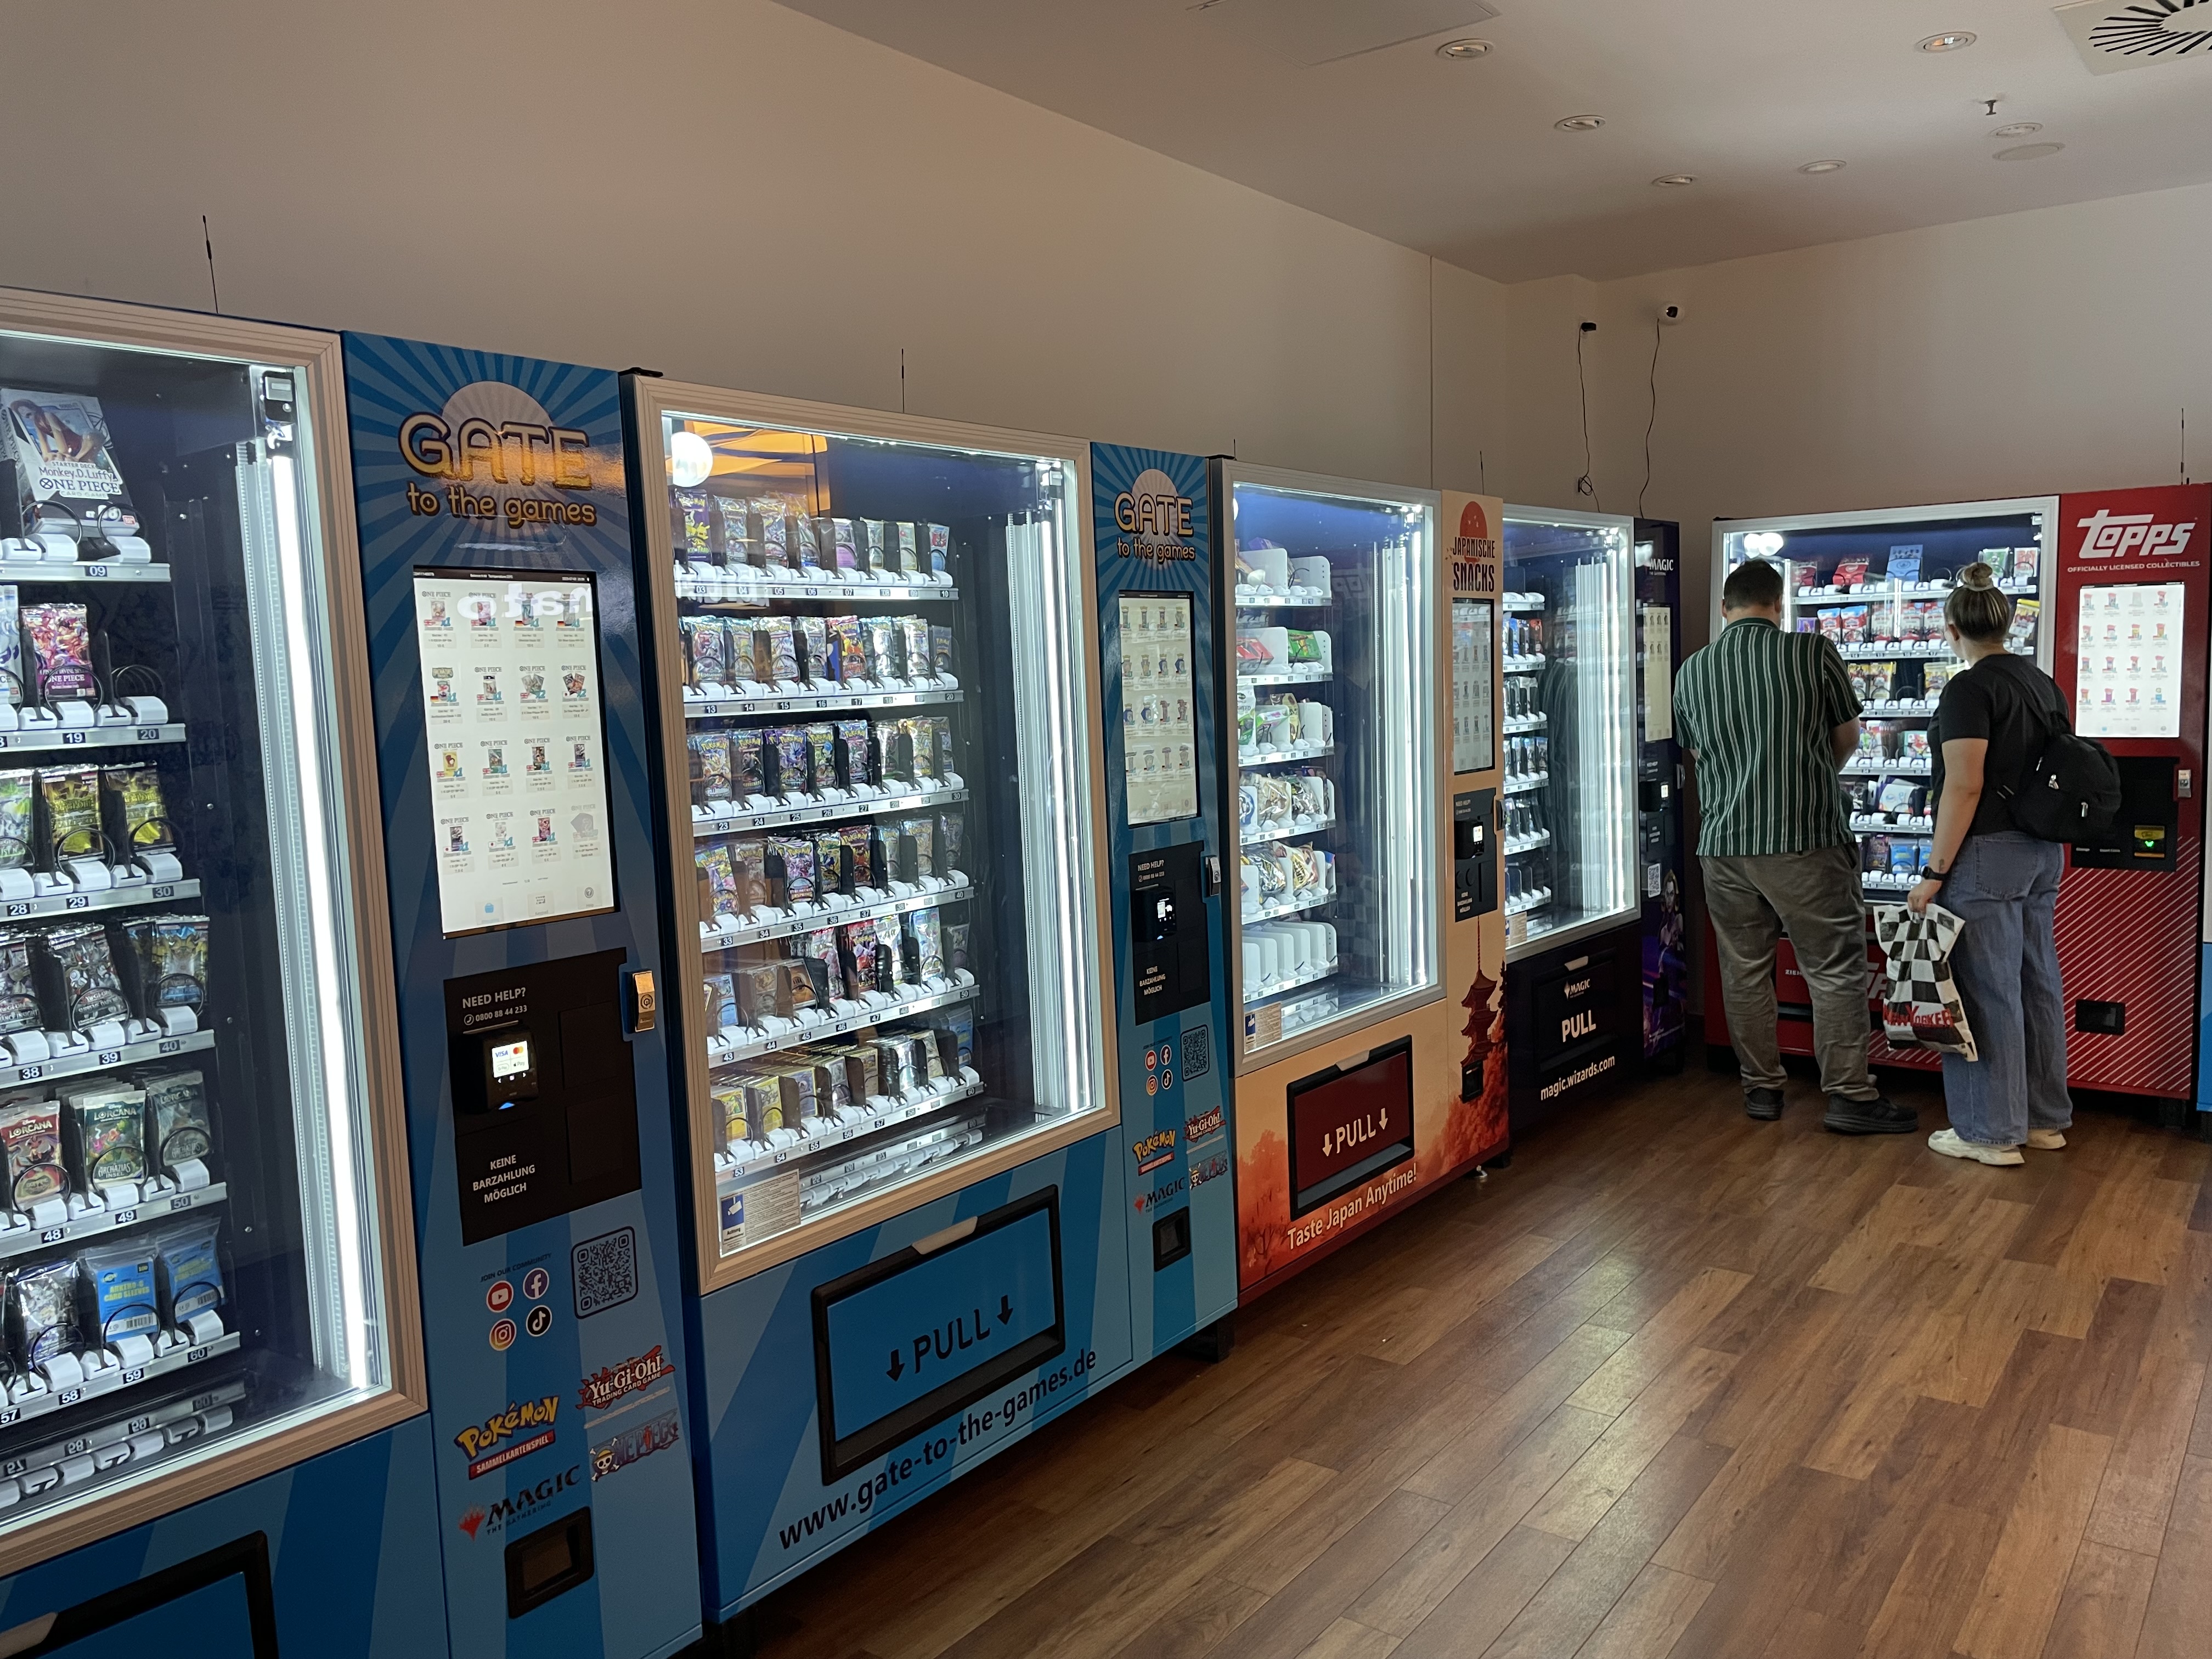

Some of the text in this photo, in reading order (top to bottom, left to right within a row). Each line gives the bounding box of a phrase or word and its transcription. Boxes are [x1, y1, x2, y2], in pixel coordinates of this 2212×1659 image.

[398, 411, 593, 490] GATE
[77, 480, 120, 494] PIECE
[407, 481, 597, 529] to the games
[1114, 491, 1194, 538] GATE
[1117, 537, 1196, 565] to the games
[1453, 537, 1496, 558] JAPANISCHE
[89, 566, 106, 577] 09
[1649, 558, 1674, 571] MAGIC
[2067, 560, 2200, 573] OFFICIALLY LICENSED COLLECTIBLES
[1453, 562, 1495, 592] SNACKS
[64, 674, 85, 682] PIECE
[66, 732, 83, 743] 19
[140, 729, 157, 740] 20
[1137, 859, 1165, 872] NEED HELP?
[155, 886, 171, 897] 30
[69, 897, 86, 908] 29
[10, 904, 27, 916] 28
[1139, 973, 1166, 987] BARZAHLUNG
[1570, 978, 1590, 995] MAGIC
[1144, 984, 1163, 996] MÖGLICH
[462, 987, 527, 1009] NEED HELP?
[475, 1005, 528, 1022] 0800 88 44 233
[1561, 1009, 1597, 1043] PULL
[162, 1041, 178, 1051] 40
[101, 1052, 119, 1064] 39
[495, 1049, 509, 1058] VISA
[22, 1068, 40, 1079] 38
[1540, 1055, 1616, 1101] magic.wizards.com
[94, 1107, 137, 1121] LORCANA
[9, 1121, 53, 1138] LORCANA
[1188, 1113, 1221, 1136] Yu-Gi-Oh!
[1335, 1114, 1377, 1154] PULL
[489, 1154, 517, 1171] KEINE
[776, 1154, 785, 1162] 54
[98, 1163, 131, 1176] ARCHAZIAS
[106, 1171, 125, 1179] INSEL
[735, 1167, 744, 1176] 53
[472, 1164, 536, 1192] BARZAHLUNG
[483, 1182, 527, 1204] MÖGLICH
[1146, 1177, 1185, 1208] MAGIC
[173, 1197, 189, 1207] 50
[1287, 1162, 1418, 1250] Taste Japan Anytime!
[118, 1211, 134, 1222] 49
[43, 1229, 61, 1242] 48
[481, 1252, 552, 1283] JOIN OUR COMMUNITY
[912, 1308, 991, 1375] PULL
[190, 1349, 205, 1361] 60
[126, 1370, 142, 1383] 59
[589, 1355, 662, 1400] Yu-Gi-Oh!
[592, 1371, 662, 1407] TRADING CARD GAME
[62, 1391, 79, 1403] 58
[1, 1412, 19, 1425] 57
[476, 1435, 549, 1474] SAMMELKARTENSPIEL
[779, 1347, 1097, 1550] www.gate-to-the-games.de
[486, 1464, 581, 1527] MAGIC
[487, 1501, 551, 1536] THE GATHERING
